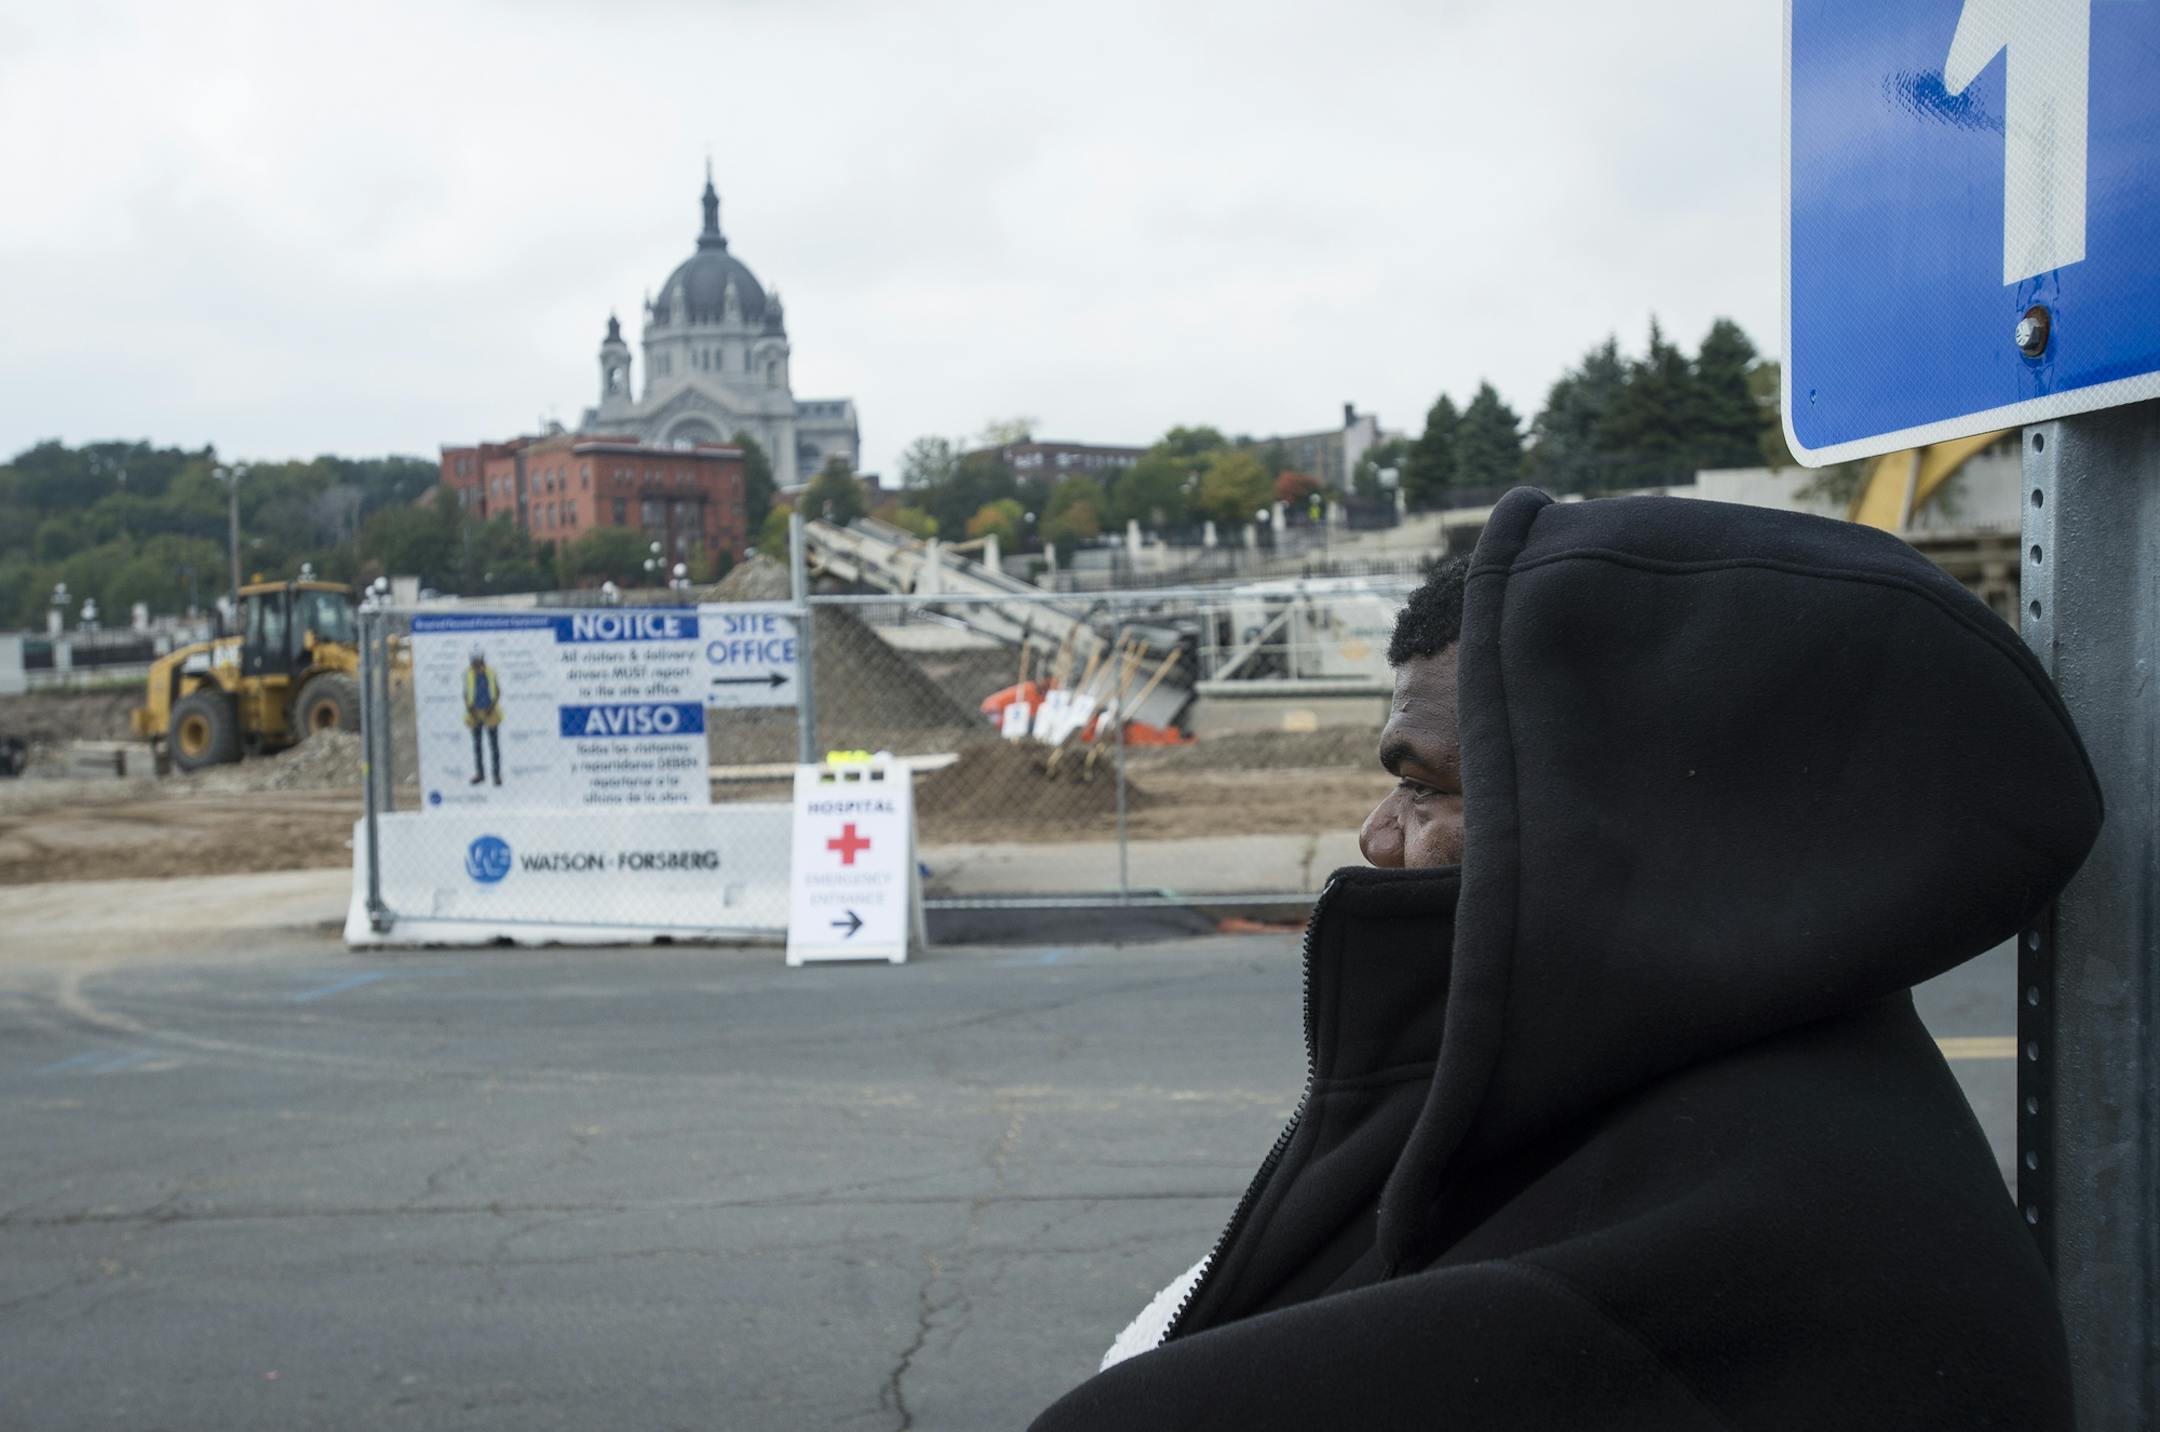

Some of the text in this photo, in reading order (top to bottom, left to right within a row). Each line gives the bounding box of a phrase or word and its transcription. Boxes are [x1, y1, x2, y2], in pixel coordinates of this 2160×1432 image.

[1944, 0, 2091, 286] 1
[573, 612, 680, 638] NOTICE
[724, 613, 775, 633] SITE
[562, 650, 577, 662] All
[583, 649, 624, 662] visitors
[646, 649, 695, 663] delivery
[706, 639, 795, 664] OFFICE
[568, 667, 691, 681] drivers MUST report
[579, 683, 680, 697] to the site office
[584, 705, 680, 734] AVISO
[807, 799, 896, 815] HOSPITAL
[520, 853, 604, 872] WATSON
[618, 850, 719, 871] FORSBERG
[805, 872, 892, 887] EMERGENCY
[810, 892, 886, 907] ENTRANCE
